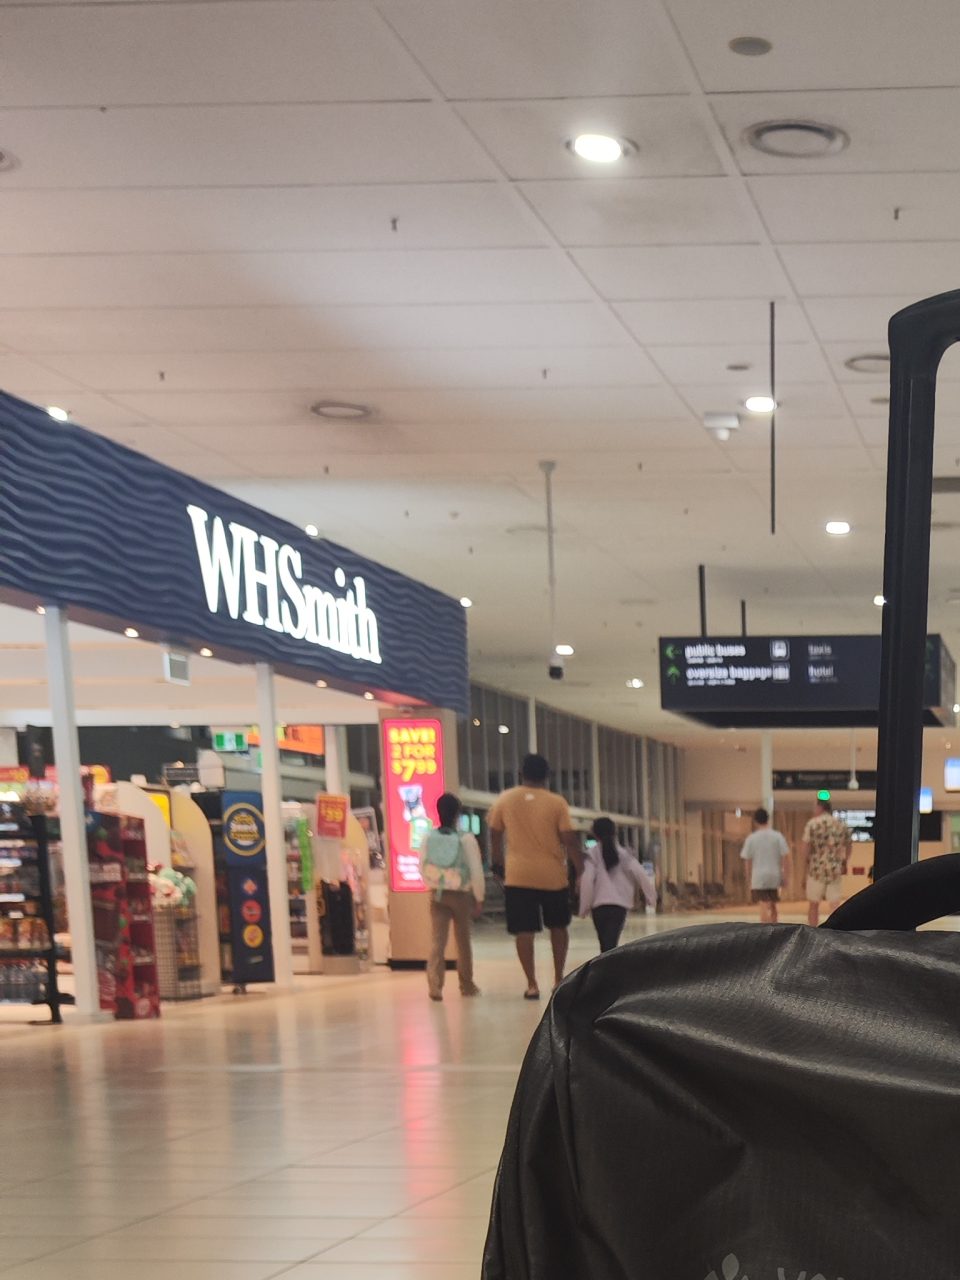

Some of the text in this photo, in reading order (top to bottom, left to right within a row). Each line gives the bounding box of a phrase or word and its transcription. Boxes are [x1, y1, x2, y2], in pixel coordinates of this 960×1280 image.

[187, 504, 382, 664] WHSmith
[389, 727, 436, 744] SAVE!
[403, 743, 436, 759] FOR
